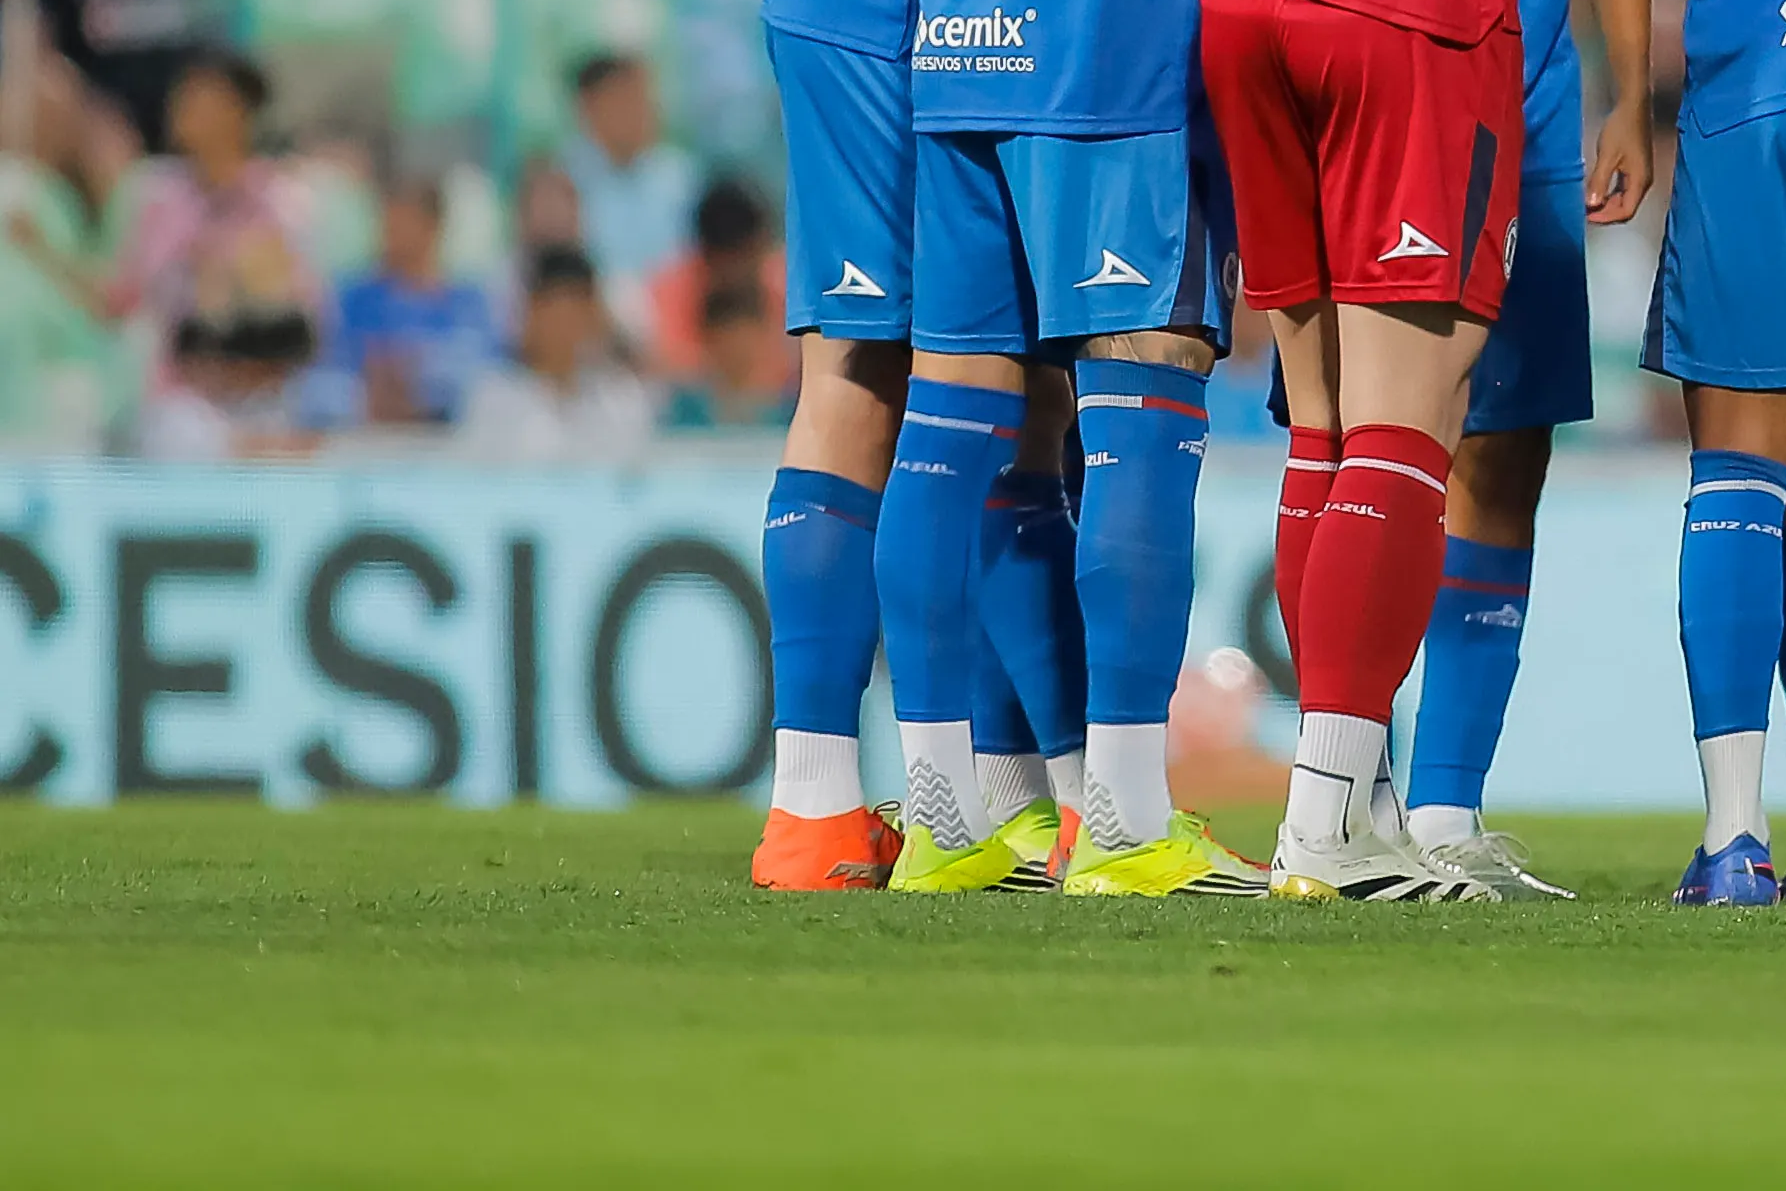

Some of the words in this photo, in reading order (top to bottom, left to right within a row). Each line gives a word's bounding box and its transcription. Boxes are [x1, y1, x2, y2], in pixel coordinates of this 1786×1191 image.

[928, 7, 1025, 48] cemix
[963, 56, 973, 71] Y
[975, 56, 1035, 72] ESTUCOS
[1691, 521, 1740, 532] CRUZ
[1745, 523, 1783, 540] AZU
